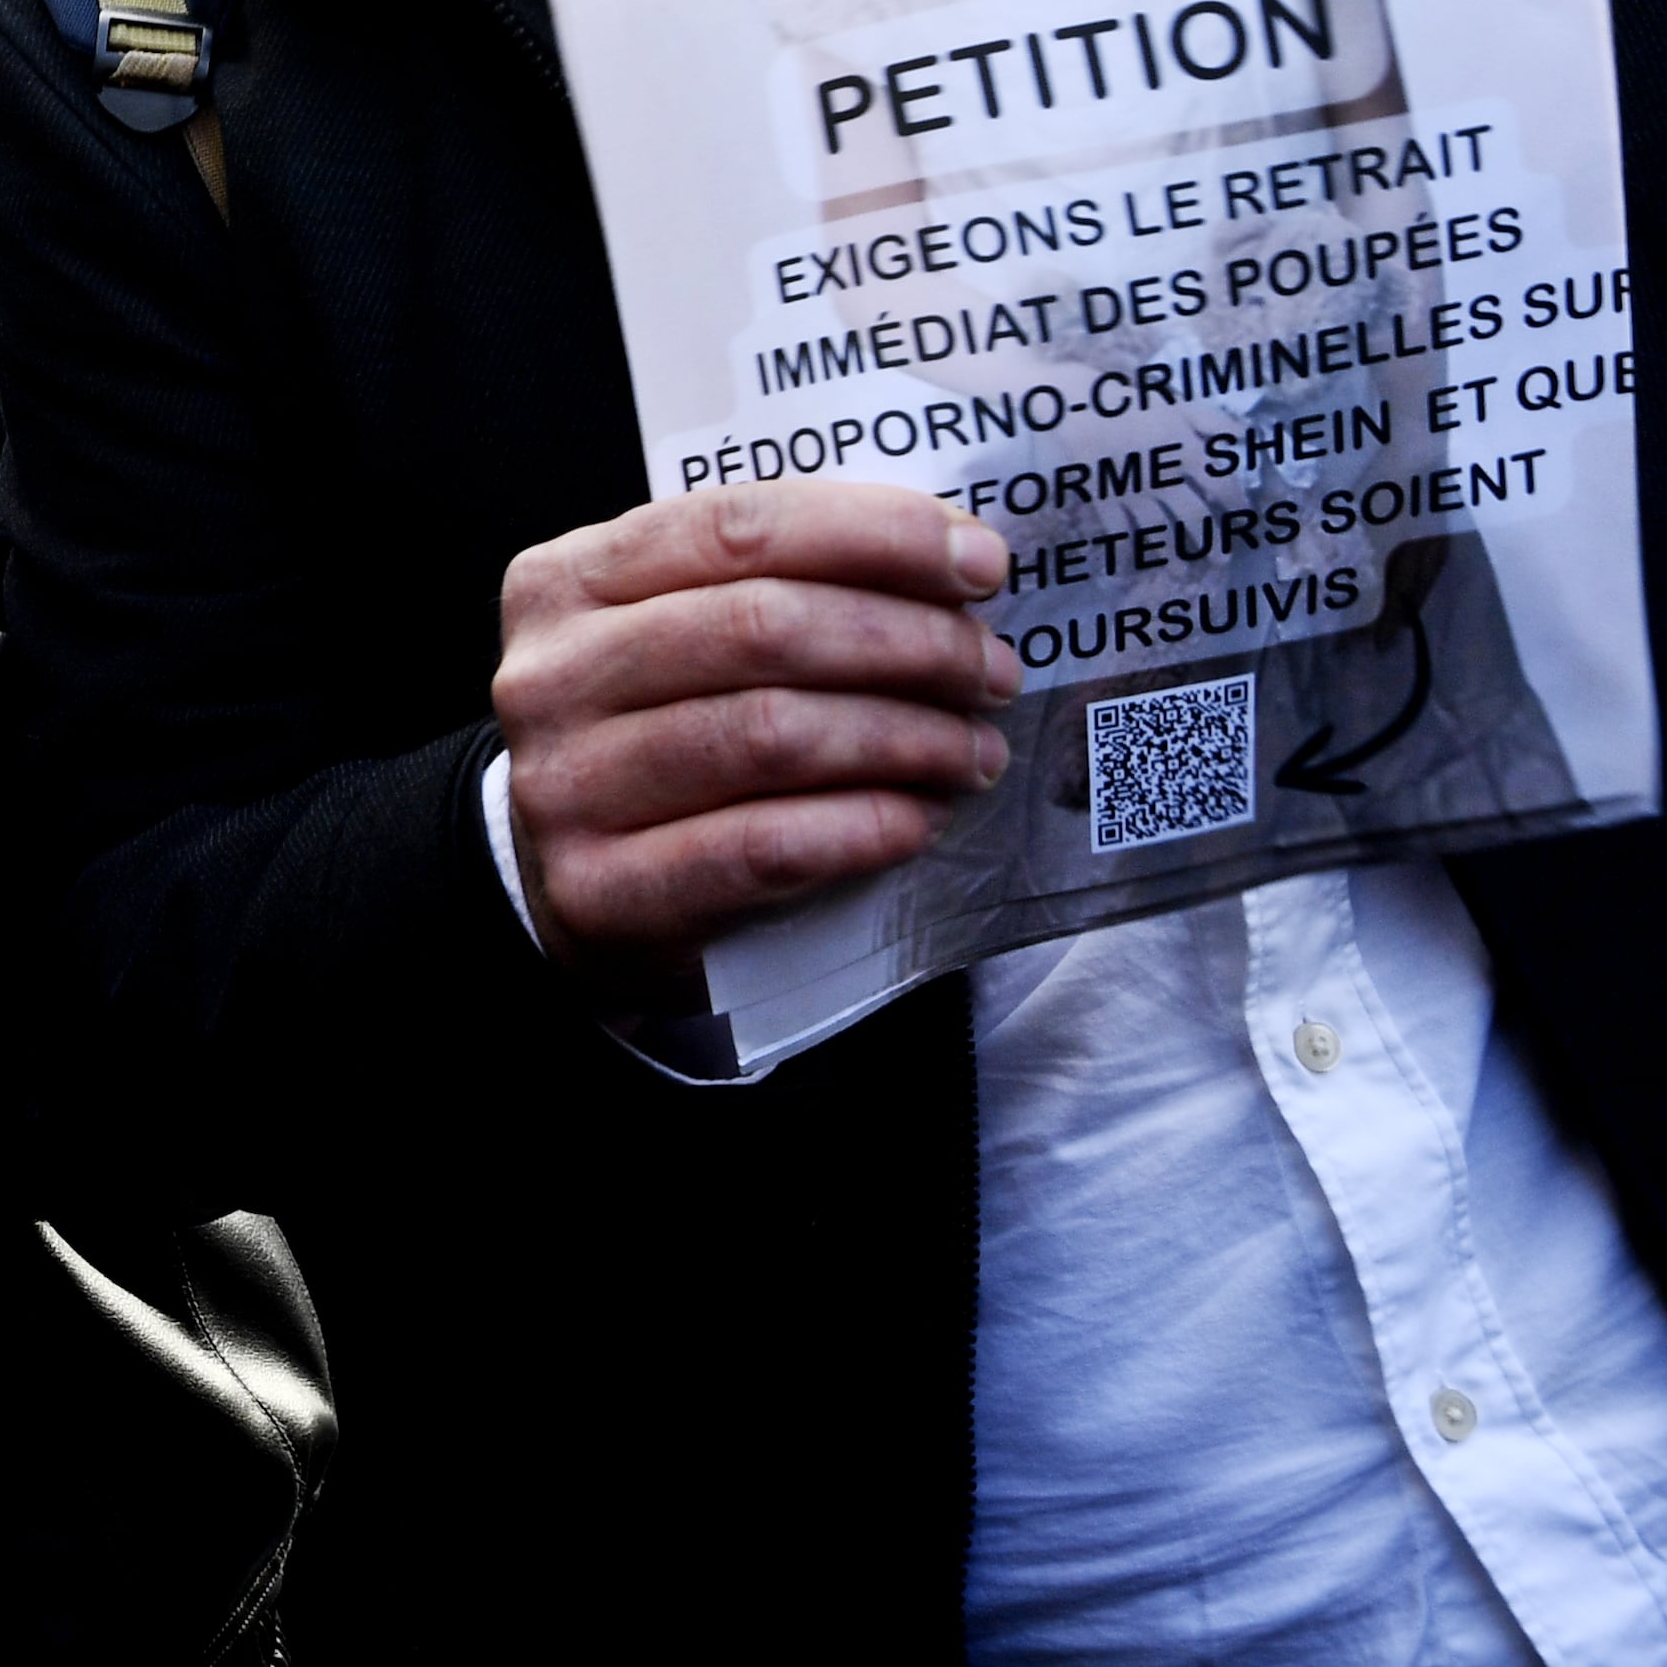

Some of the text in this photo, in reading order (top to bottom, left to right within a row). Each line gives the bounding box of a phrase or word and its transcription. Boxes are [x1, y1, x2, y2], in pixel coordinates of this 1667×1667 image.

[756, 206, 1523, 395] IMMÉDIAT DES POUPÉES
[775, 124, 1493, 305] EXIGEONS LE RETRAIT
[681, 293, 1503, 492] PÉDOPORNO-CRIMINELLES
[936, 351, 1635, 521] FORME SHEIN ET QUE
[1003, 450, 1547, 594] HETEURS SOIENT
[996, 568, 1360, 668] OURSUIVIS
